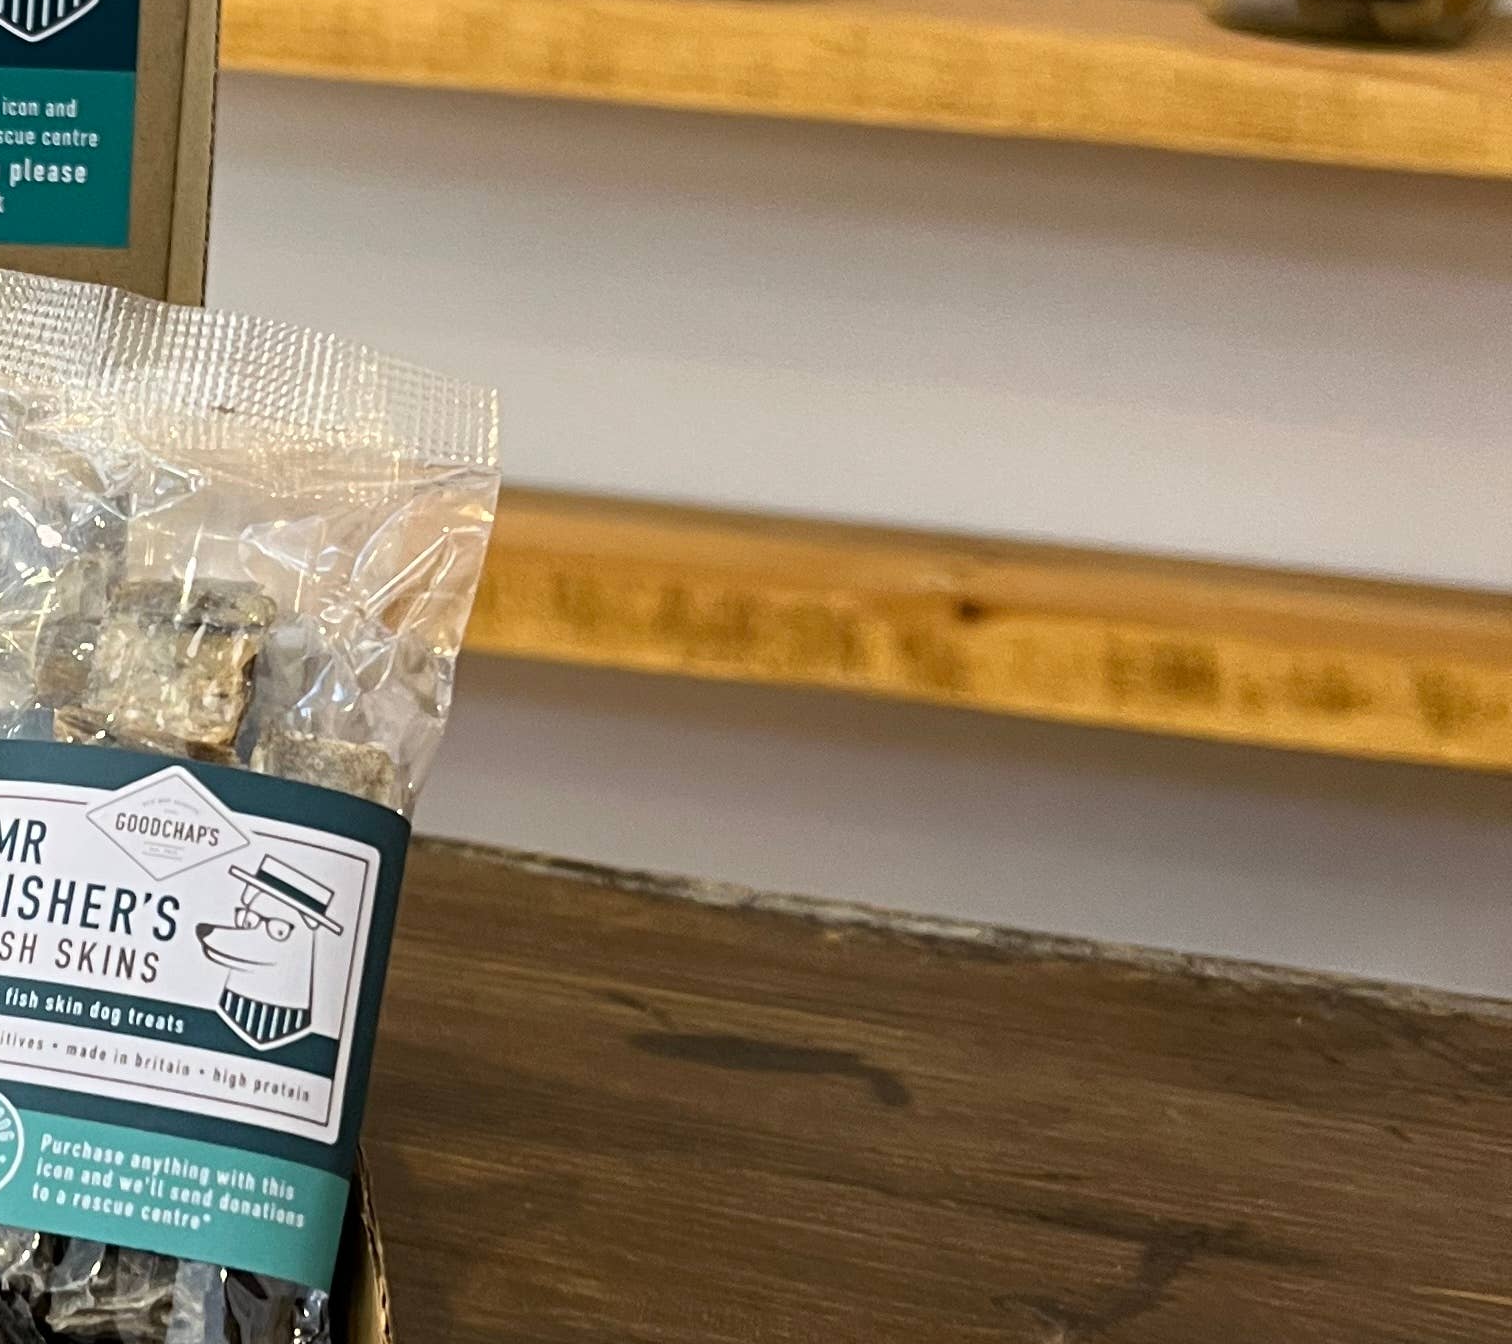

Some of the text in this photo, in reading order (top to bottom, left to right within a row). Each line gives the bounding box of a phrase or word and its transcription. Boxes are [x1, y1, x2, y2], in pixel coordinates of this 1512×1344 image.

[2, 96, 39, 117] icon
[45, 98, 78, 118] and
[41, 129, 99, 148] centre
[8, 157, 88, 188] please
[54, 938, 160, 984] SKINS
[5, 987, 39, 1009] fish
[45, 994, 83, 1016] skin
[89, 1001, 122, 1027] dog
[128, 1007, 185, 1034] treats
[66, 1044, 108, 1061] made
[113, 1049, 128, 1065] in
[135, 1052, 191, 1076] britain
[213, 1067, 247, 1089] high
[253, 1077, 310, 1102] protein
[40, 1133, 296, 1201] Purchase anything with this
[32, 1182, 49, 1202] to
[55, 1189, 67, 1205] a
[72, 1193, 135, 1217] rescue
[36, 1157, 306, 1229] icon and we'll send donations
